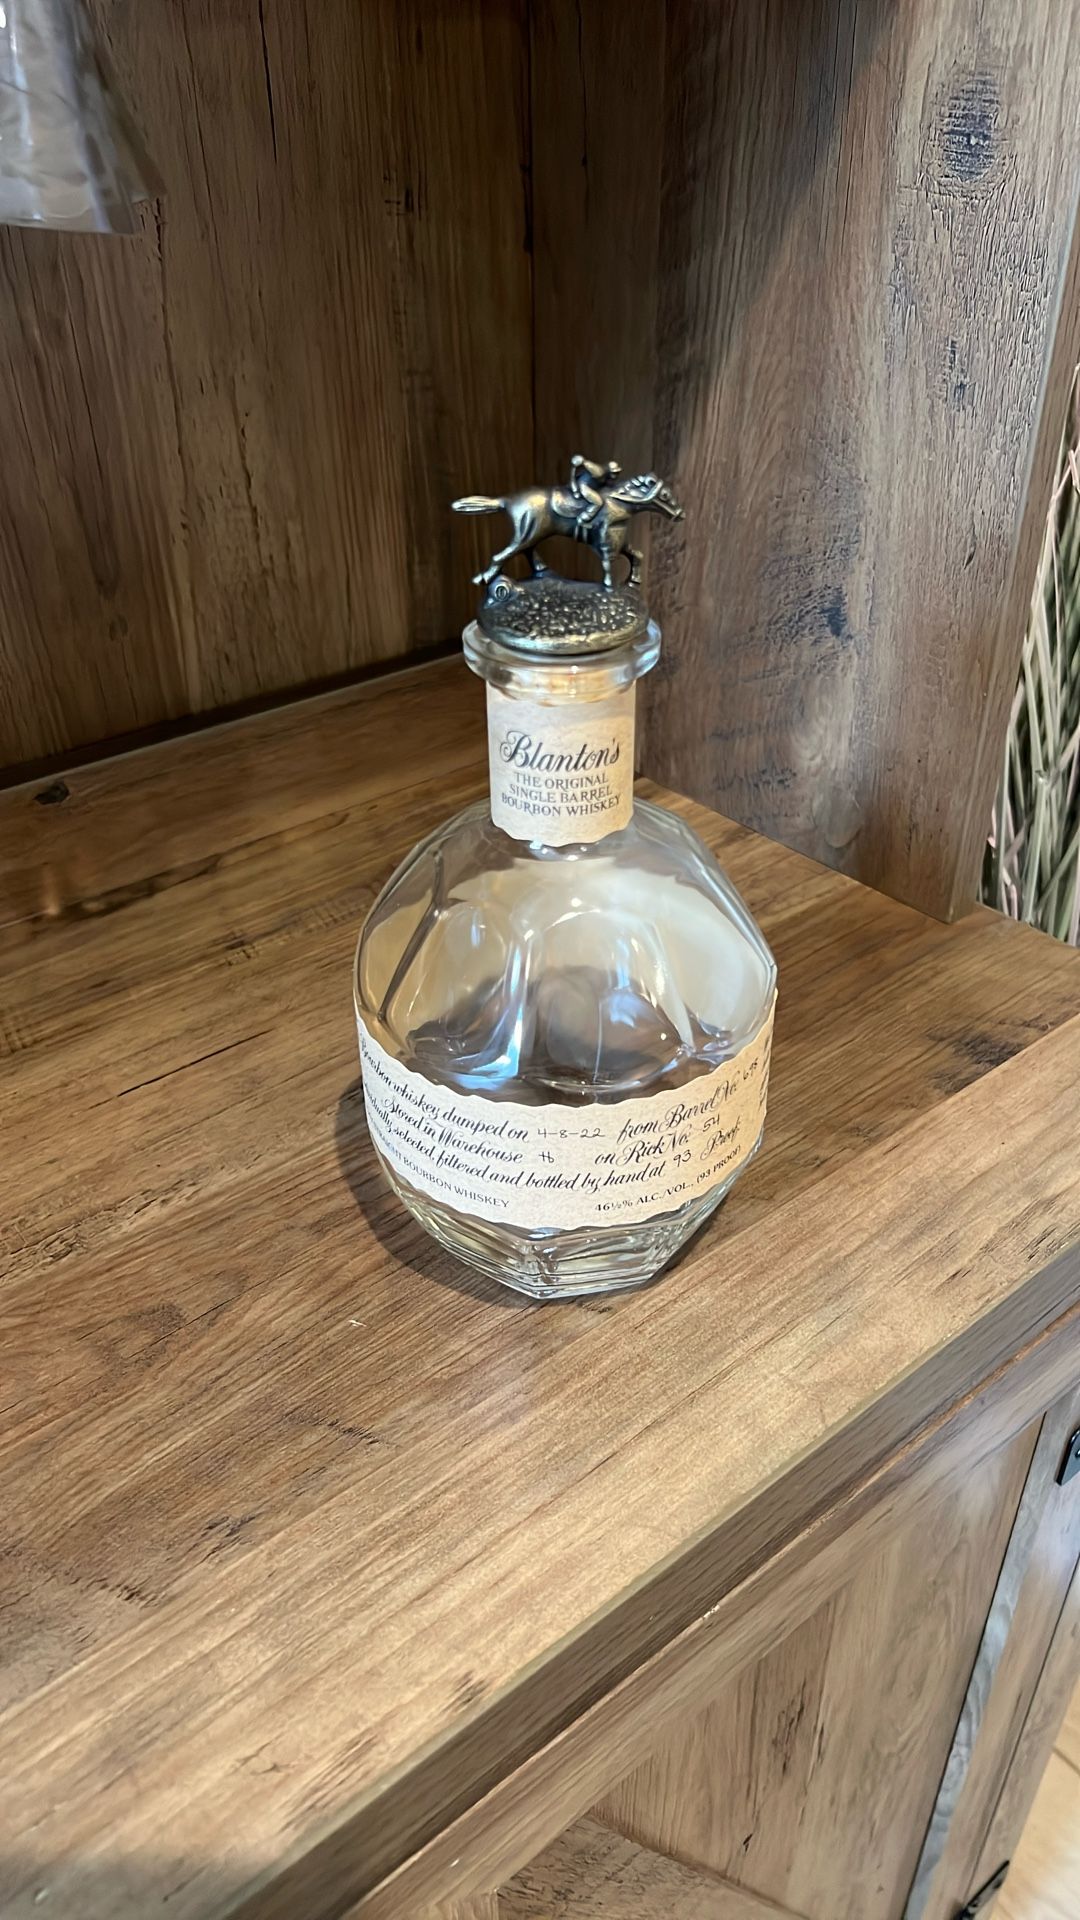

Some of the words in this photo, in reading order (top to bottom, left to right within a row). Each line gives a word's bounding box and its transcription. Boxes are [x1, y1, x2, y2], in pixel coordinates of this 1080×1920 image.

[500, 731, 620, 772] Blanton's
[509, 784, 556, 803] SINGLE
[560, 786, 613, 804] BARREL
[514, 771, 542, 787] THE
[544, 773, 609, 792] ORIGINAL
[501, 792, 561, 816] BOURBON
[566, 794, 621, 816] WHISKEY
[382, 1096, 425, 1130] Stored
[422, 1122, 437, 1140] in
[436, 1122, 523, 1163] Warehouse
[594, 1153, 617, 1165] on
[616, 1136, 666, 1165] Rick
[702, 1113, 720, 1133] 54
[391, 1082, 440, 1120] whiskey
[442, 1107, 509, 1140] dumped
[507, 1128, 529, 1144] on
[537, 1127, 605, 1139] 4-8-22
[616, 1118, 659, 1145] from
[658, 1086, 720, 1132] Barrel
[403, 1157, 452, 1191] BOURBON
[453, 1185, 510, 1208] WHISKEY
[435, 1150, 490, 1182] filtered
[488, 1171, 525, 1189] and
[524, 1172, 580, 1191] bottled
[580, 1173, 601, 1194] by
[603, 1163, 650, 1187] hand
[649, 1160, 667, 1178] at
[673, 1149, 692, 1168] 93
